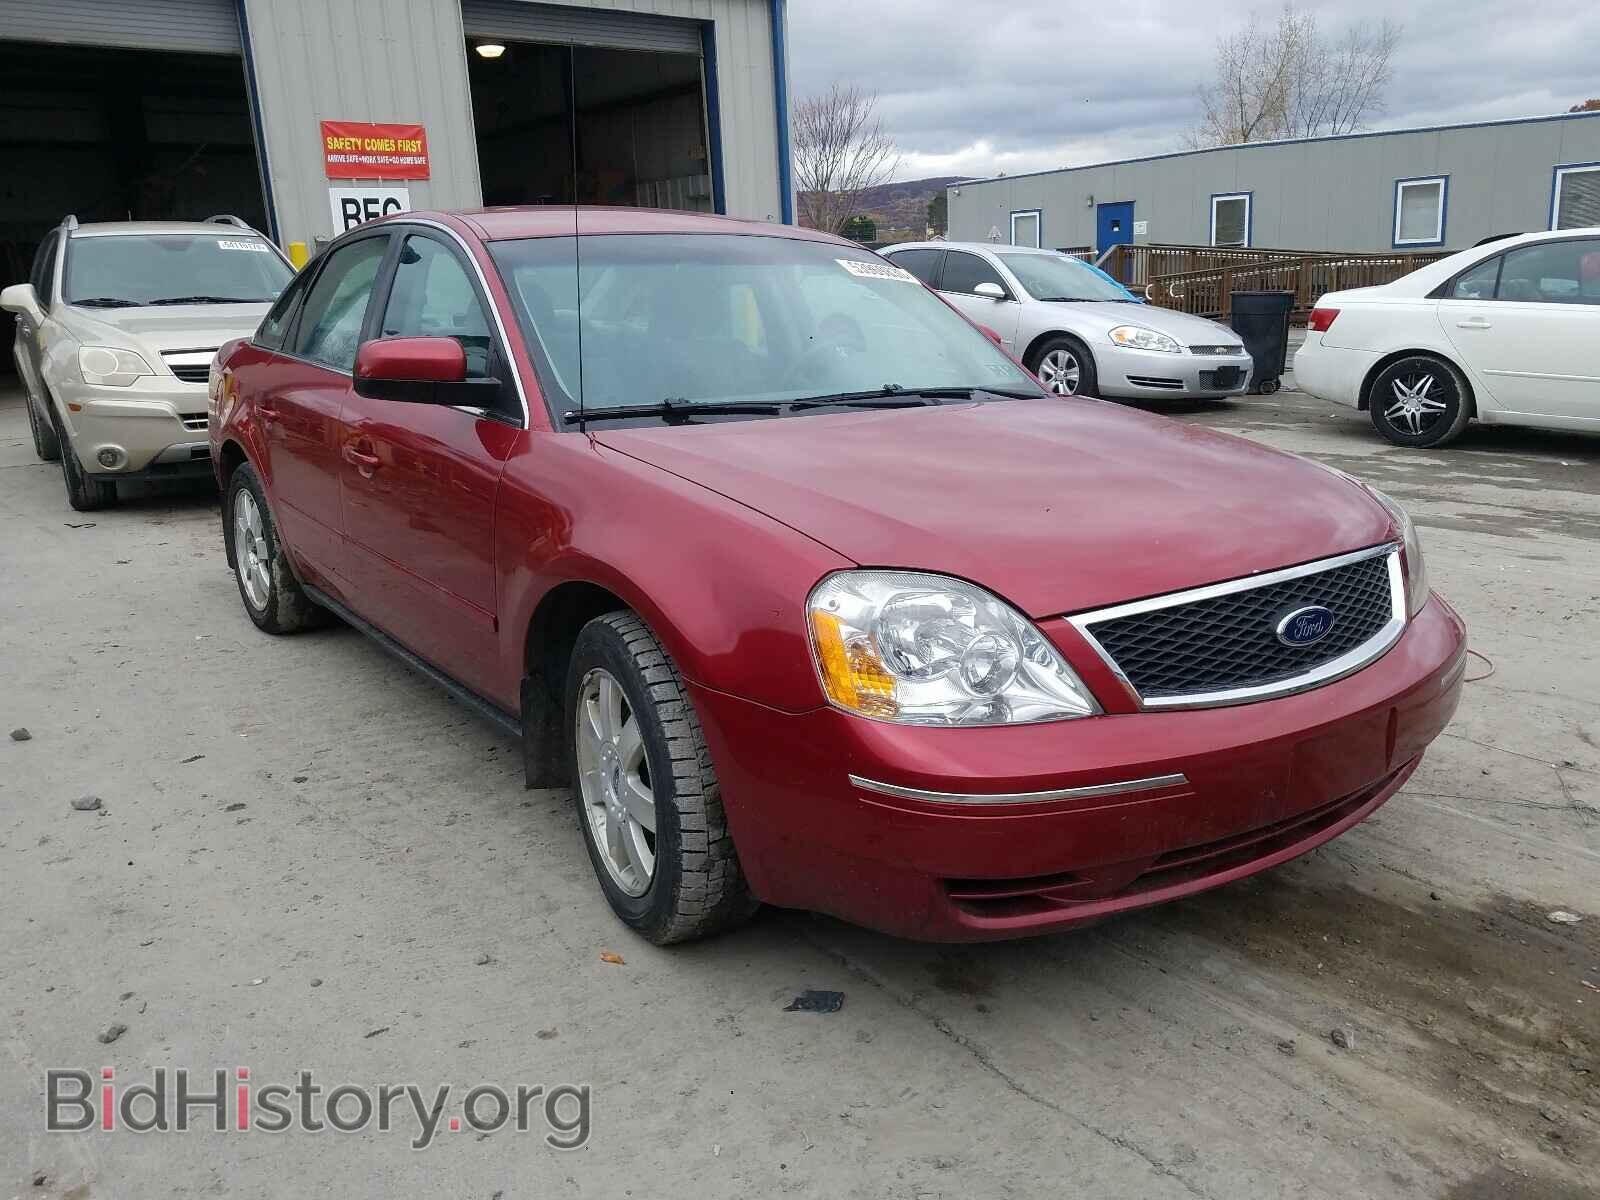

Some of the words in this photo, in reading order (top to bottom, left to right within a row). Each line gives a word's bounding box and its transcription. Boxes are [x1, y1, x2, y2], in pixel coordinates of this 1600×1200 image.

[326, 136, 362, 151] SAFETY
[364, 138, 396, 152] COMES
[398, 139, 422, 153] FIRST
[1294, 613, 1325, 640] Ford
